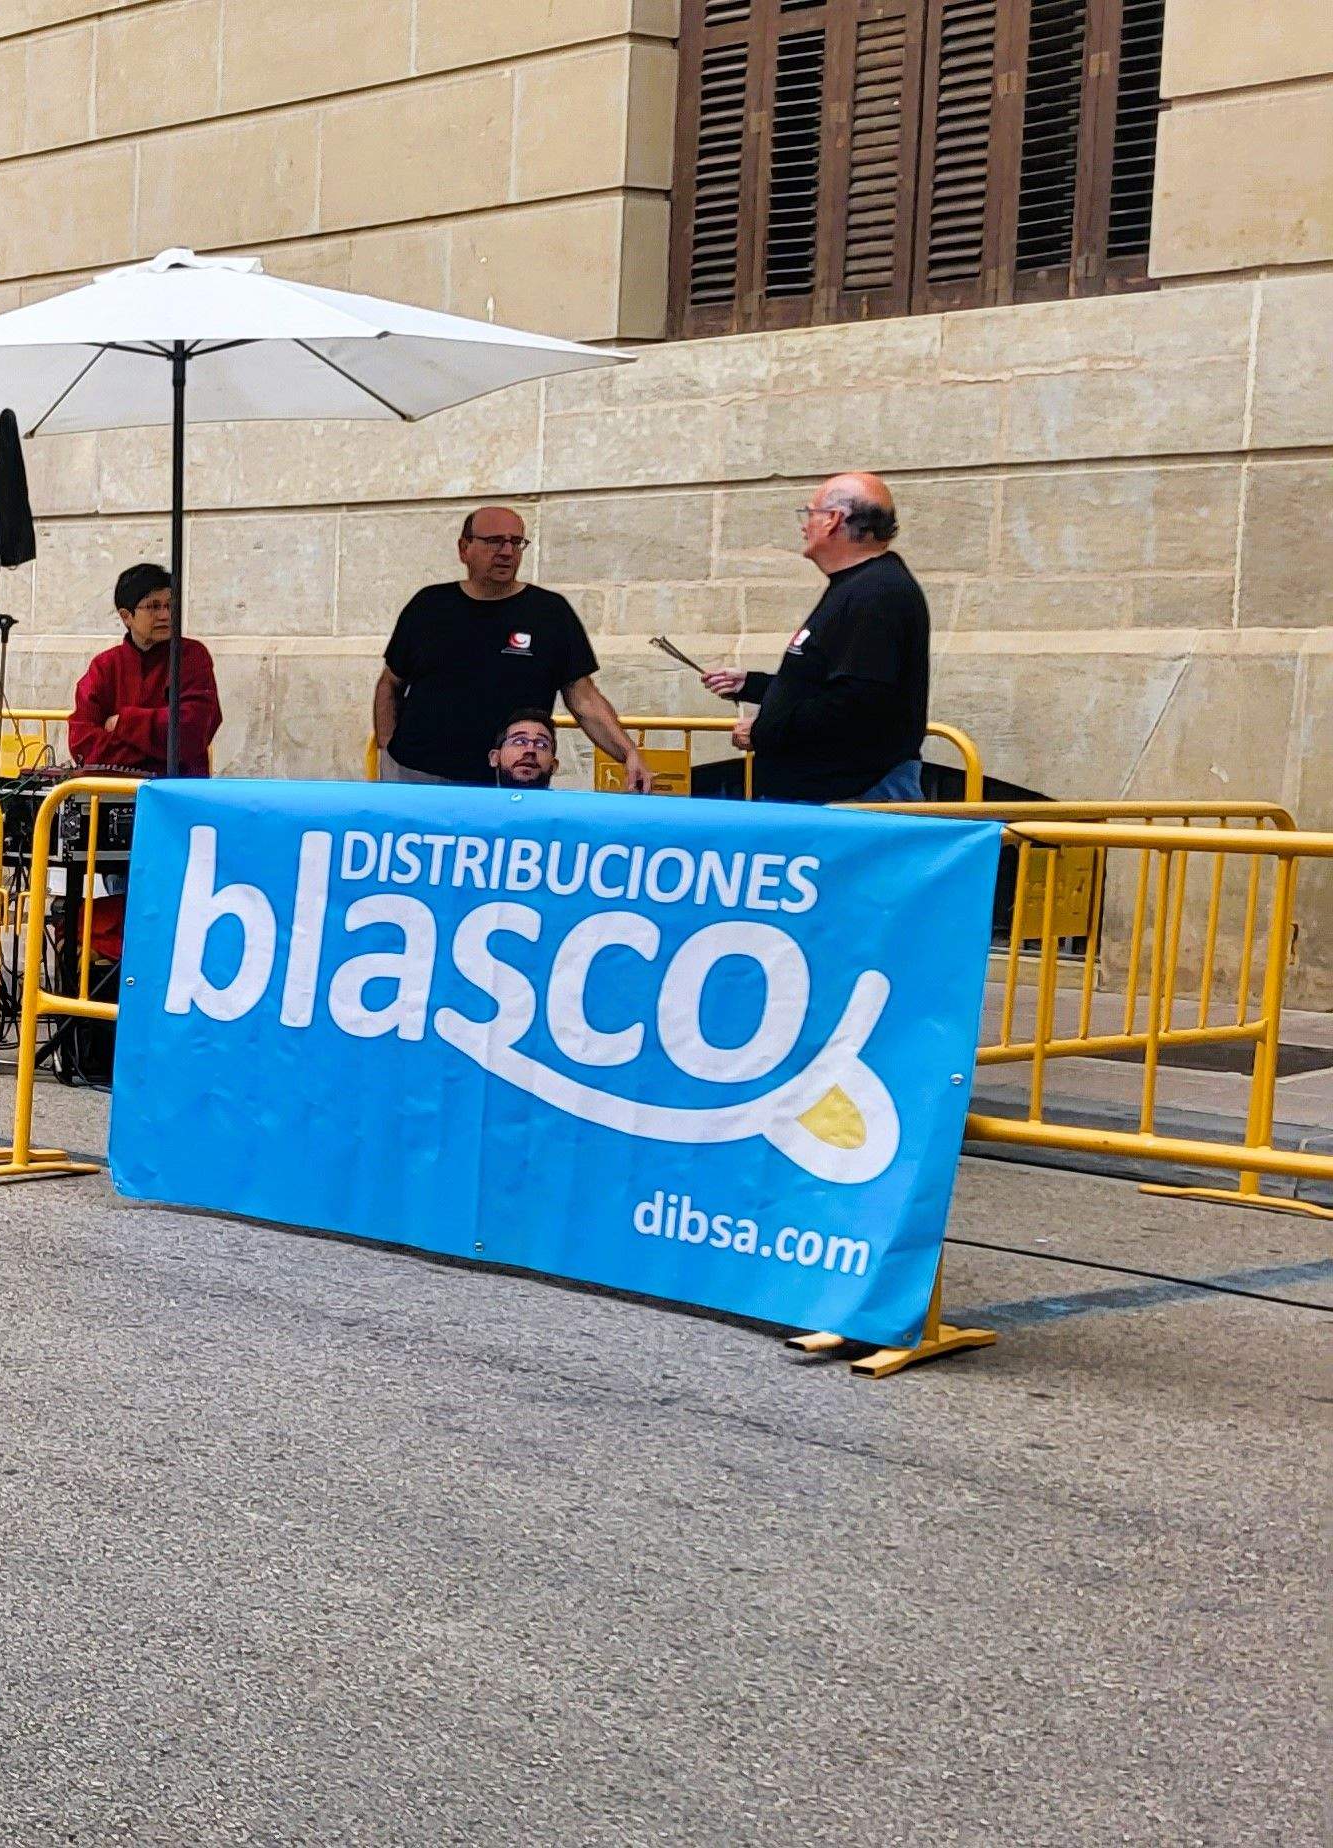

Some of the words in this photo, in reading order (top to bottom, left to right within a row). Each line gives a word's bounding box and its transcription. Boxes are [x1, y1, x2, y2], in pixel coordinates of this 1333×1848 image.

[341, 829, 821, 915] DISTRIBUCIONES
[163, 824, 812, 1085] blasco
[633, 1190, 871, 1278] dibsa.com
